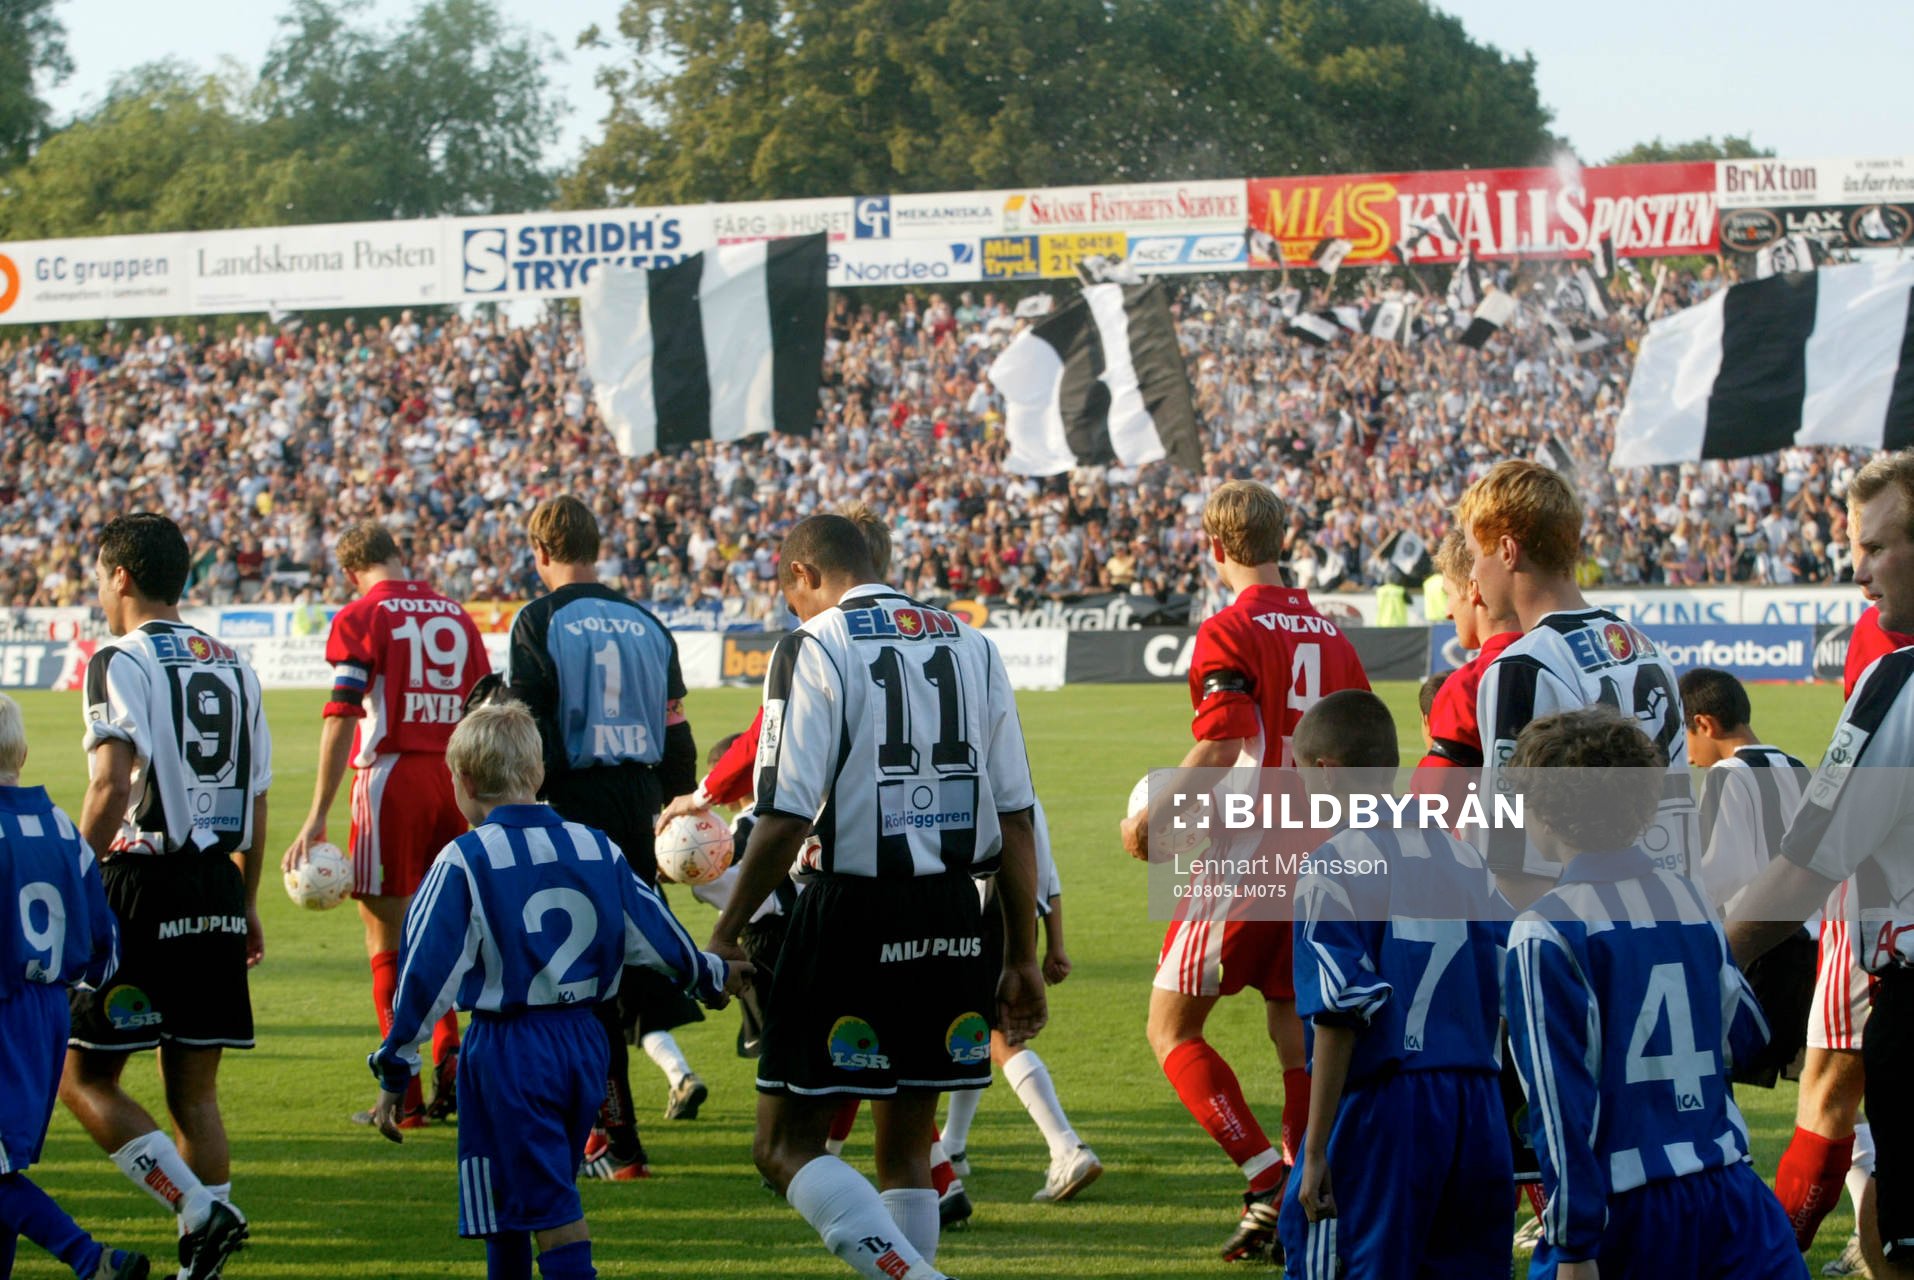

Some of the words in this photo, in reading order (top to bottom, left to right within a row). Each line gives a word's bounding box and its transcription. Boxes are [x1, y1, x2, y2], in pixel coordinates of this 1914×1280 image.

[1726, 164, 1816, 192] BriXton
[1786, 211, 1843, 230] LAX
[197, 244, 343, 278] Landskrona
[354, 240, 434, 270] Posten
[1137, 250, 1168, 260] NCC
[1197, 248, 1228, 258] NCC
[35, 256, 67, 281] GC
[74, 256, 169, 285] gruppen
[845, 259, 949, 281] Nordea
[379, 598, 462, 617] VOLVO
[564, 616, 645, 637] VOLVO
[844, 607, 960, 641] ELON
[1252, 612, 1337, 637] VOLVO
[149, 635, 238, 665] ELON
[392, 616, 468, 689] 19
[0, 645, 46, 685] ET
[594, 640, 621, 718] 1
[1287, 643, 1323, 711] 4
[870, 645, 977, 776] 11
[186, 672, 237, 783] 9
[884, 811, 971, 831] Rörläggaren
[19, 882, 65, 984] 9
[522, 887, 598, 1005] 2
[1392, 914, 1468, 1051] 7
[113, 1011, 163, 1030] LSR
[1405, 1034, 1420, 1050] ICA
[1626, 962, 1716, 1112] 4
[832, 1052, 890, 1070] LSR
[1677, 1093, 1702, 1110] ICA
